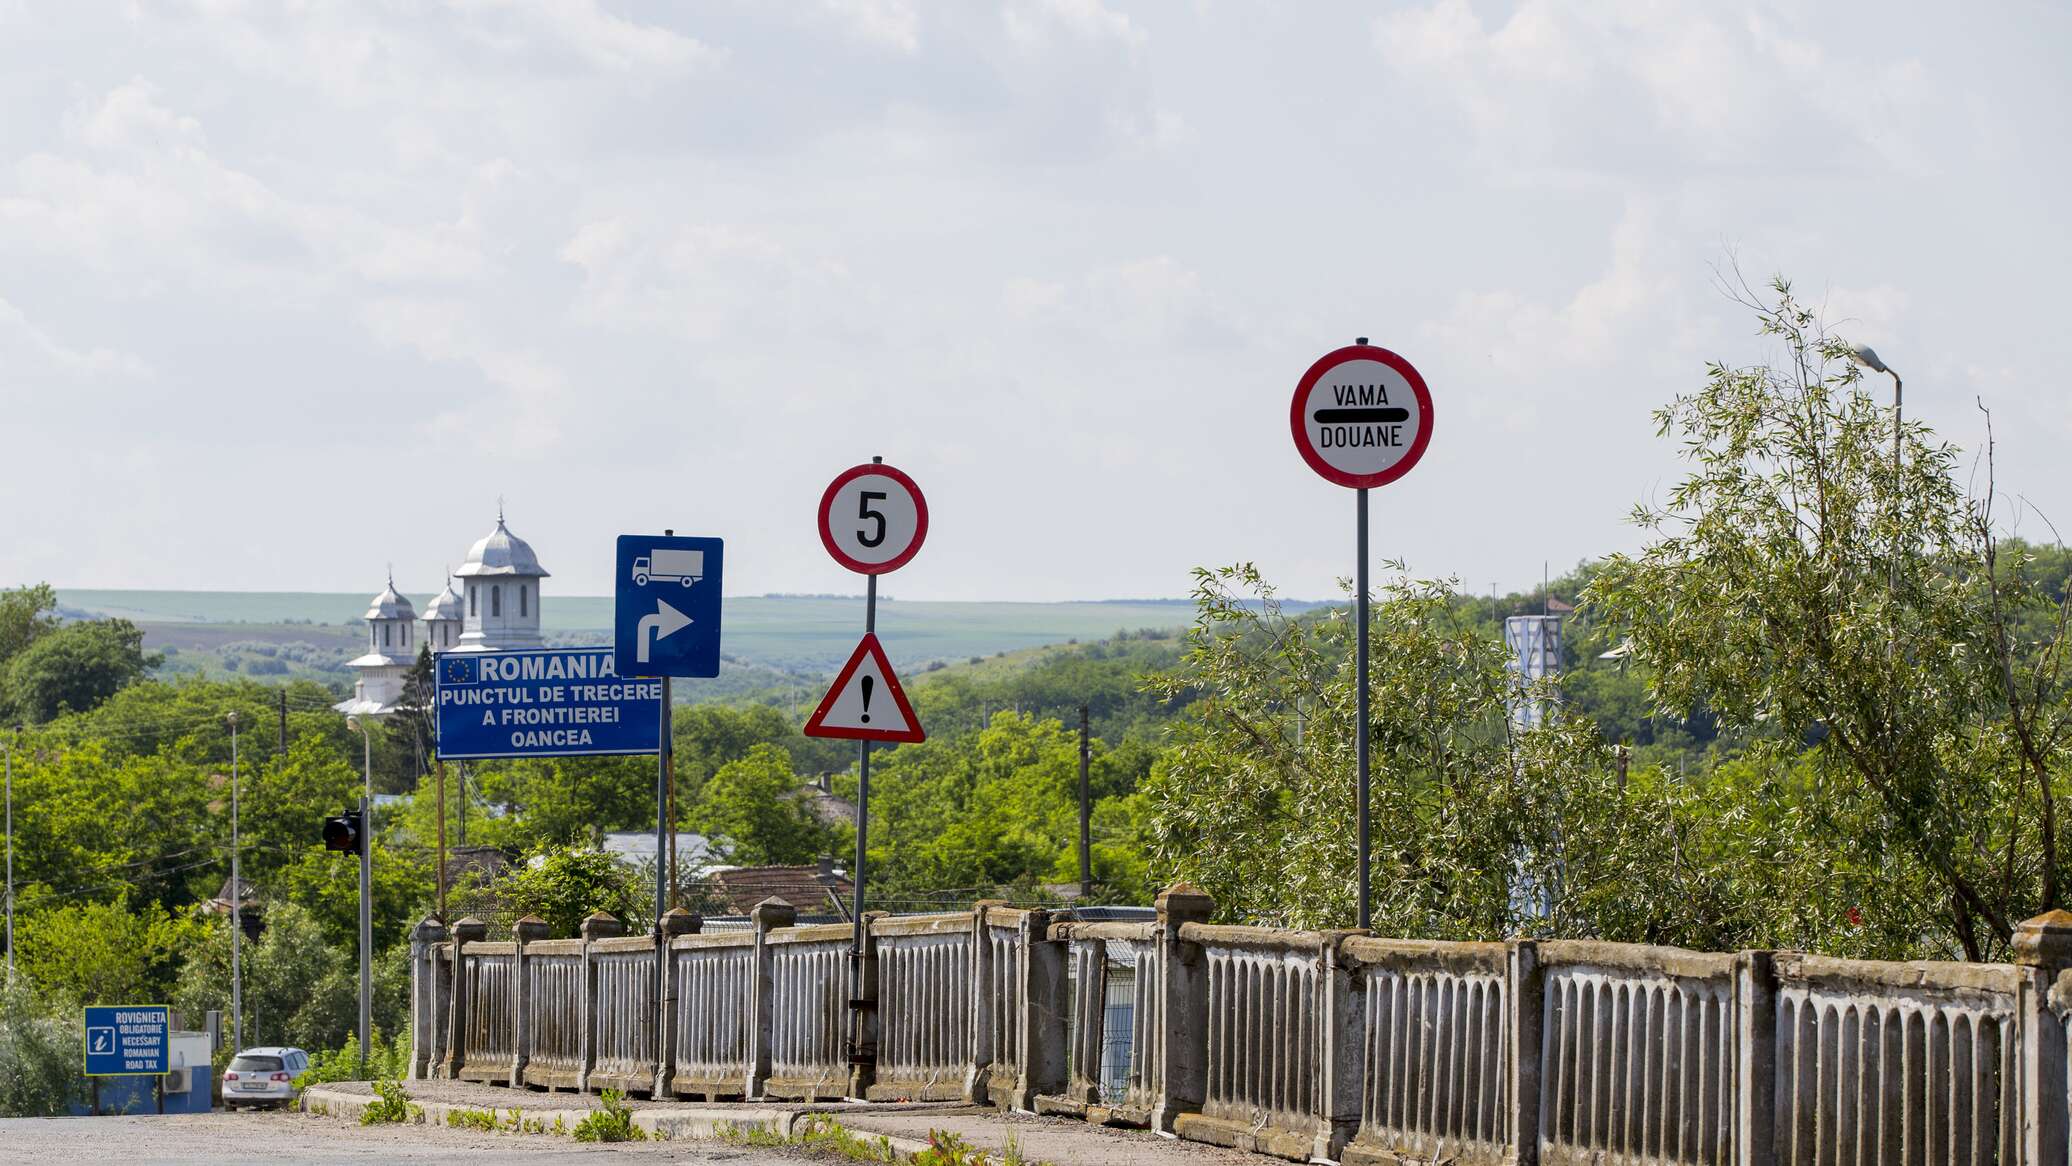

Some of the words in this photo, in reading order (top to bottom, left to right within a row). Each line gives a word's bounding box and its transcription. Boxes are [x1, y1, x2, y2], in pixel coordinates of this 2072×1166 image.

[1333, 384, 1389, 406] VAMA
[1321, 425, 1403, 448] DOUANE
[856, 490, 887, 548] 5
[479, 655, 619, 682] ROMANIA
[440, 687, 534, 706] PUNCTUL
[539, 686, 565, 702] DE
[571, 683, 661, 702] TRECERE
[482, 710, 496, 726] A
[502, 707, 620, 725] FRONTIEREI
[511, 730, 593, 748] OANCEA
[115, 1011, 167, 1024] ROVIGNIETA
[119, 1024, 163, 1034] OBLIGATORIE
[122, 1036, 161, 1046] NECESSARY
[123, 1047, 160, 1058] ROMANIAN
[125, 1060, 144, 1070] ROAD
[145, 1059, 158, 1070] TAX
